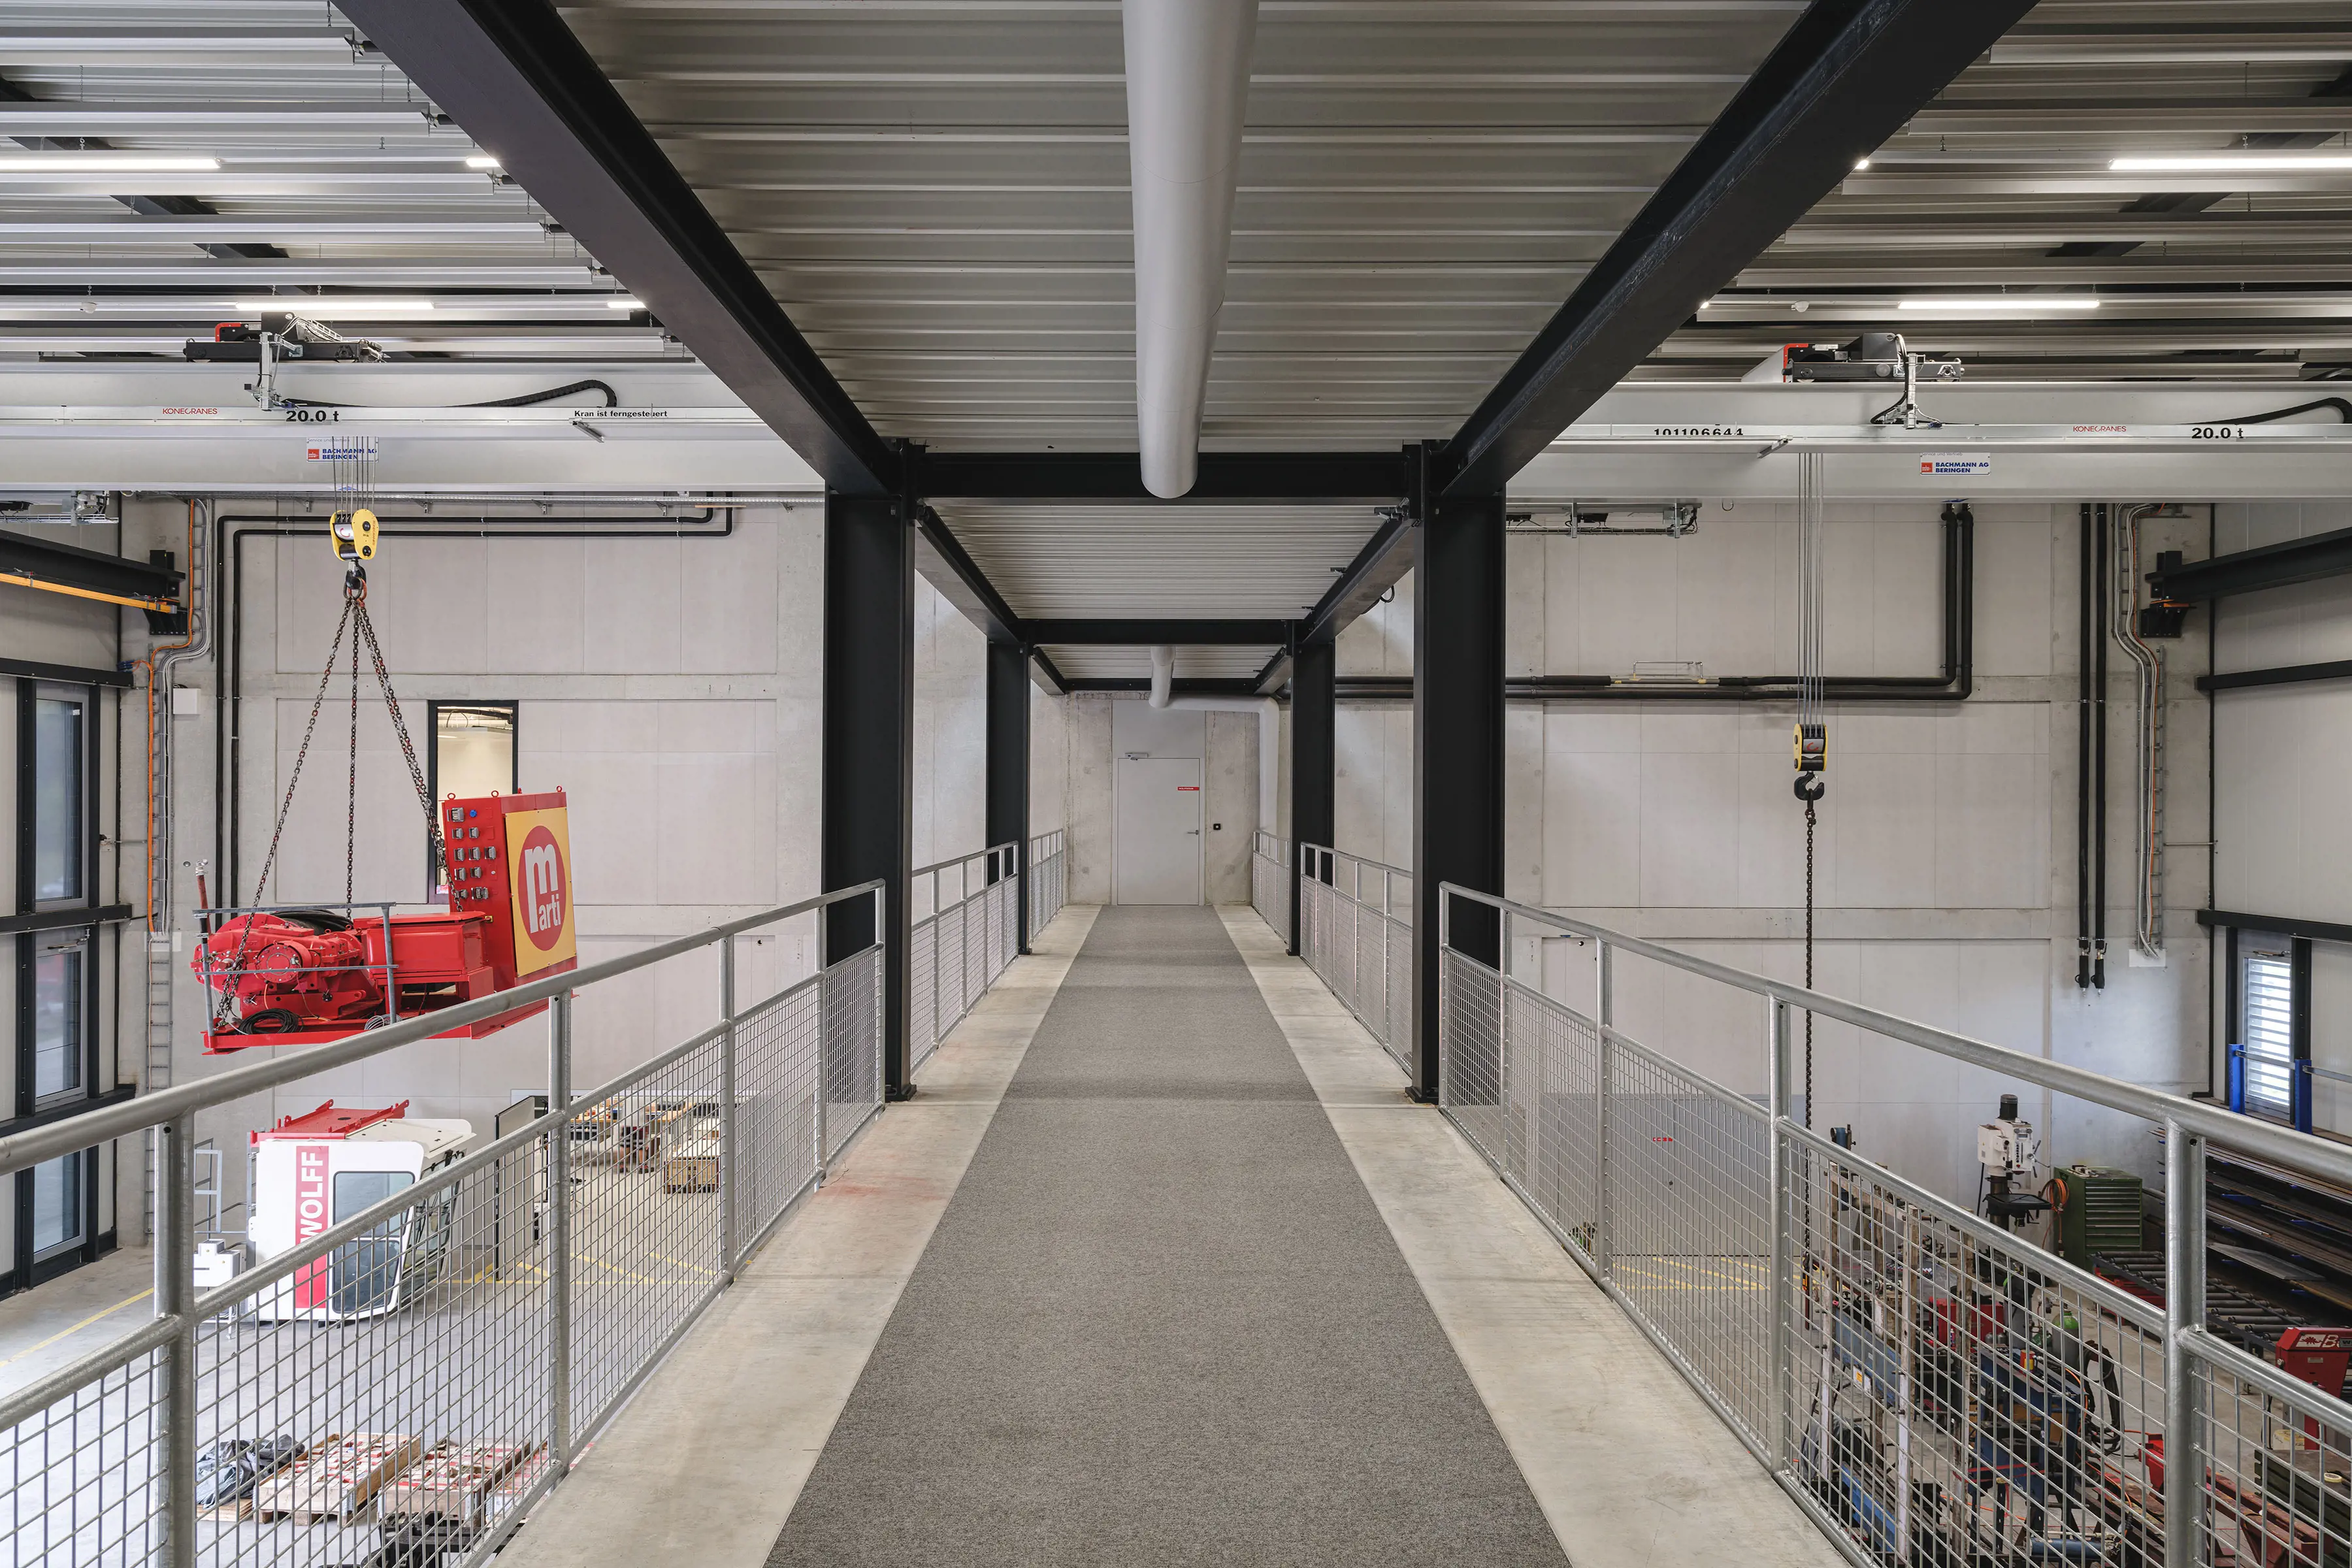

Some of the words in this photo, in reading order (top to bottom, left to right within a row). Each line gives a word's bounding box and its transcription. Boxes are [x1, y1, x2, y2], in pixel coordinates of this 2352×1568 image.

[286, 410, 327, 422] 20.0
[333, 411, 339, 422] t
[2191, 427, 2231, 439] 20.0
[2237, 428, 2244, 438] t
[300, 1152, 323, 1243] WOLFF
